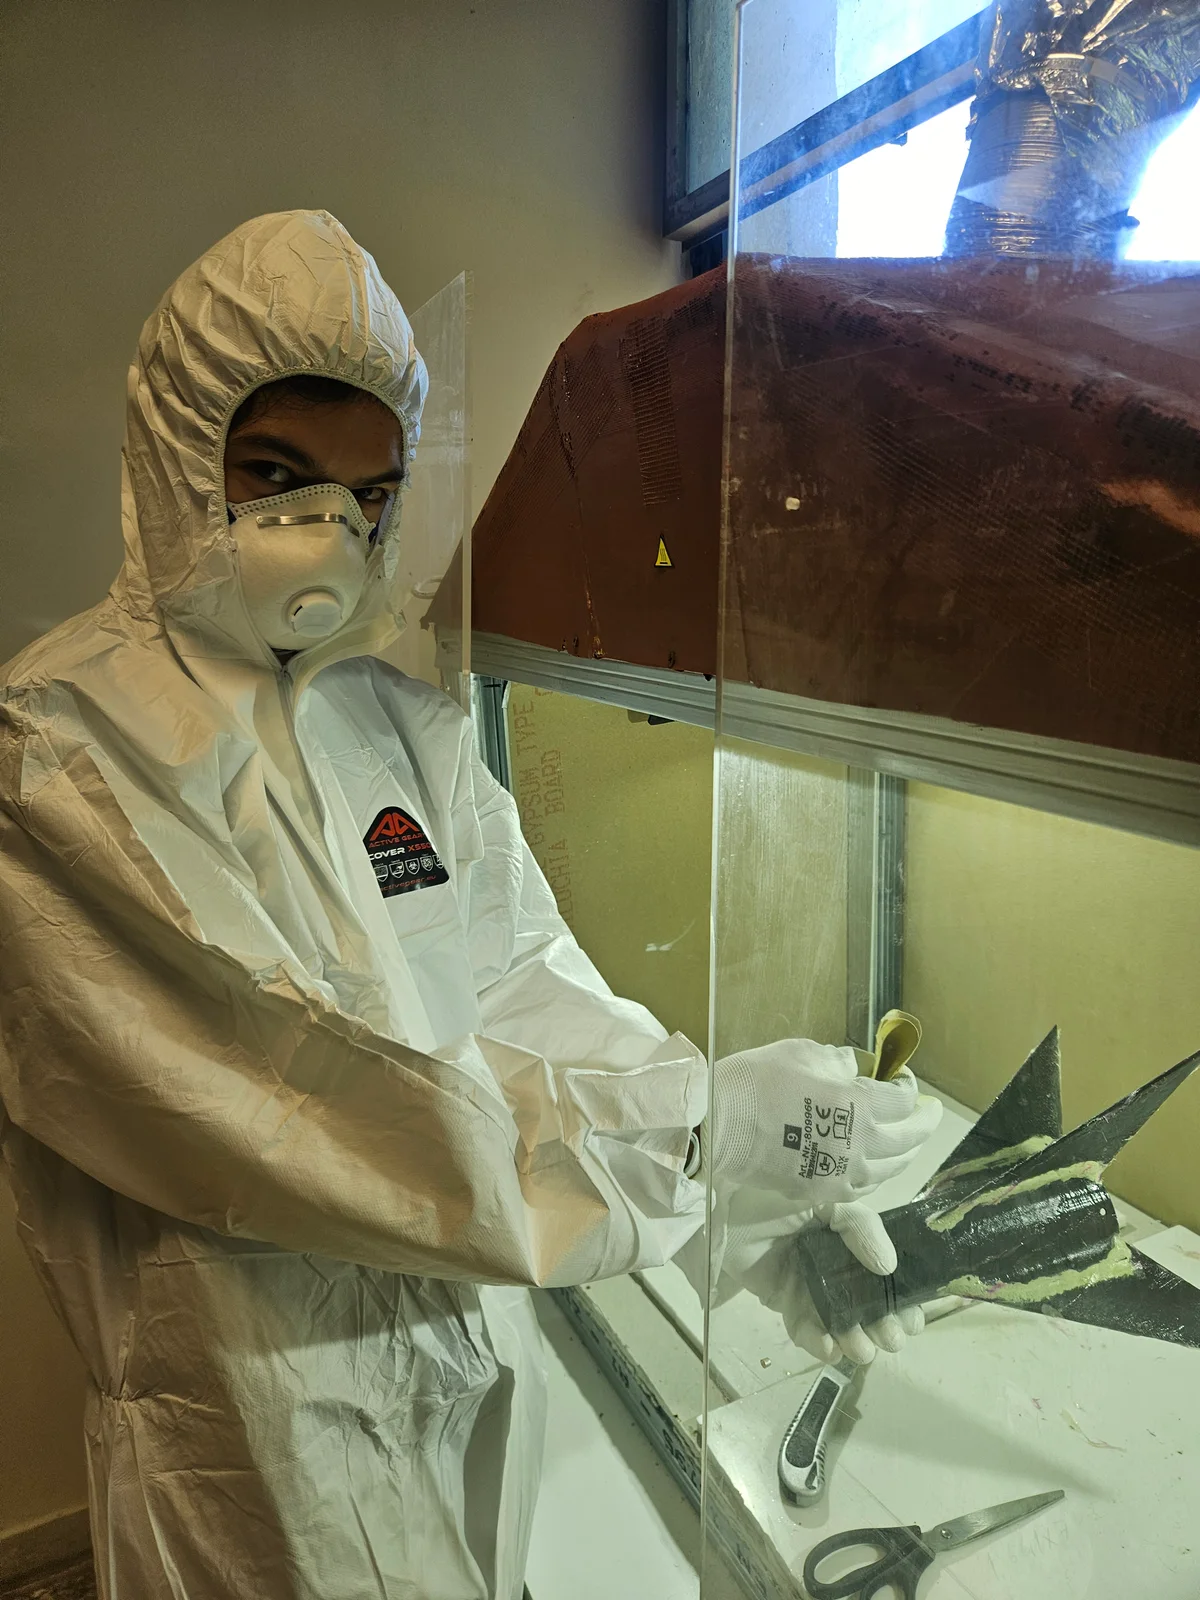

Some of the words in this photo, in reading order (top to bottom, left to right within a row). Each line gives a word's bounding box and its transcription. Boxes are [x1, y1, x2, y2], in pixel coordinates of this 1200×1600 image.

[512, 700, 538, 757] TYPE
[541, 749, 566, 817] BOARD
[518, 767, 545, 848] GYPSUM
[368, 847, 406, 861] COVER
[369, 836, 400, 848] ACTIVE
[786, 1132, 799, 1142] 9
